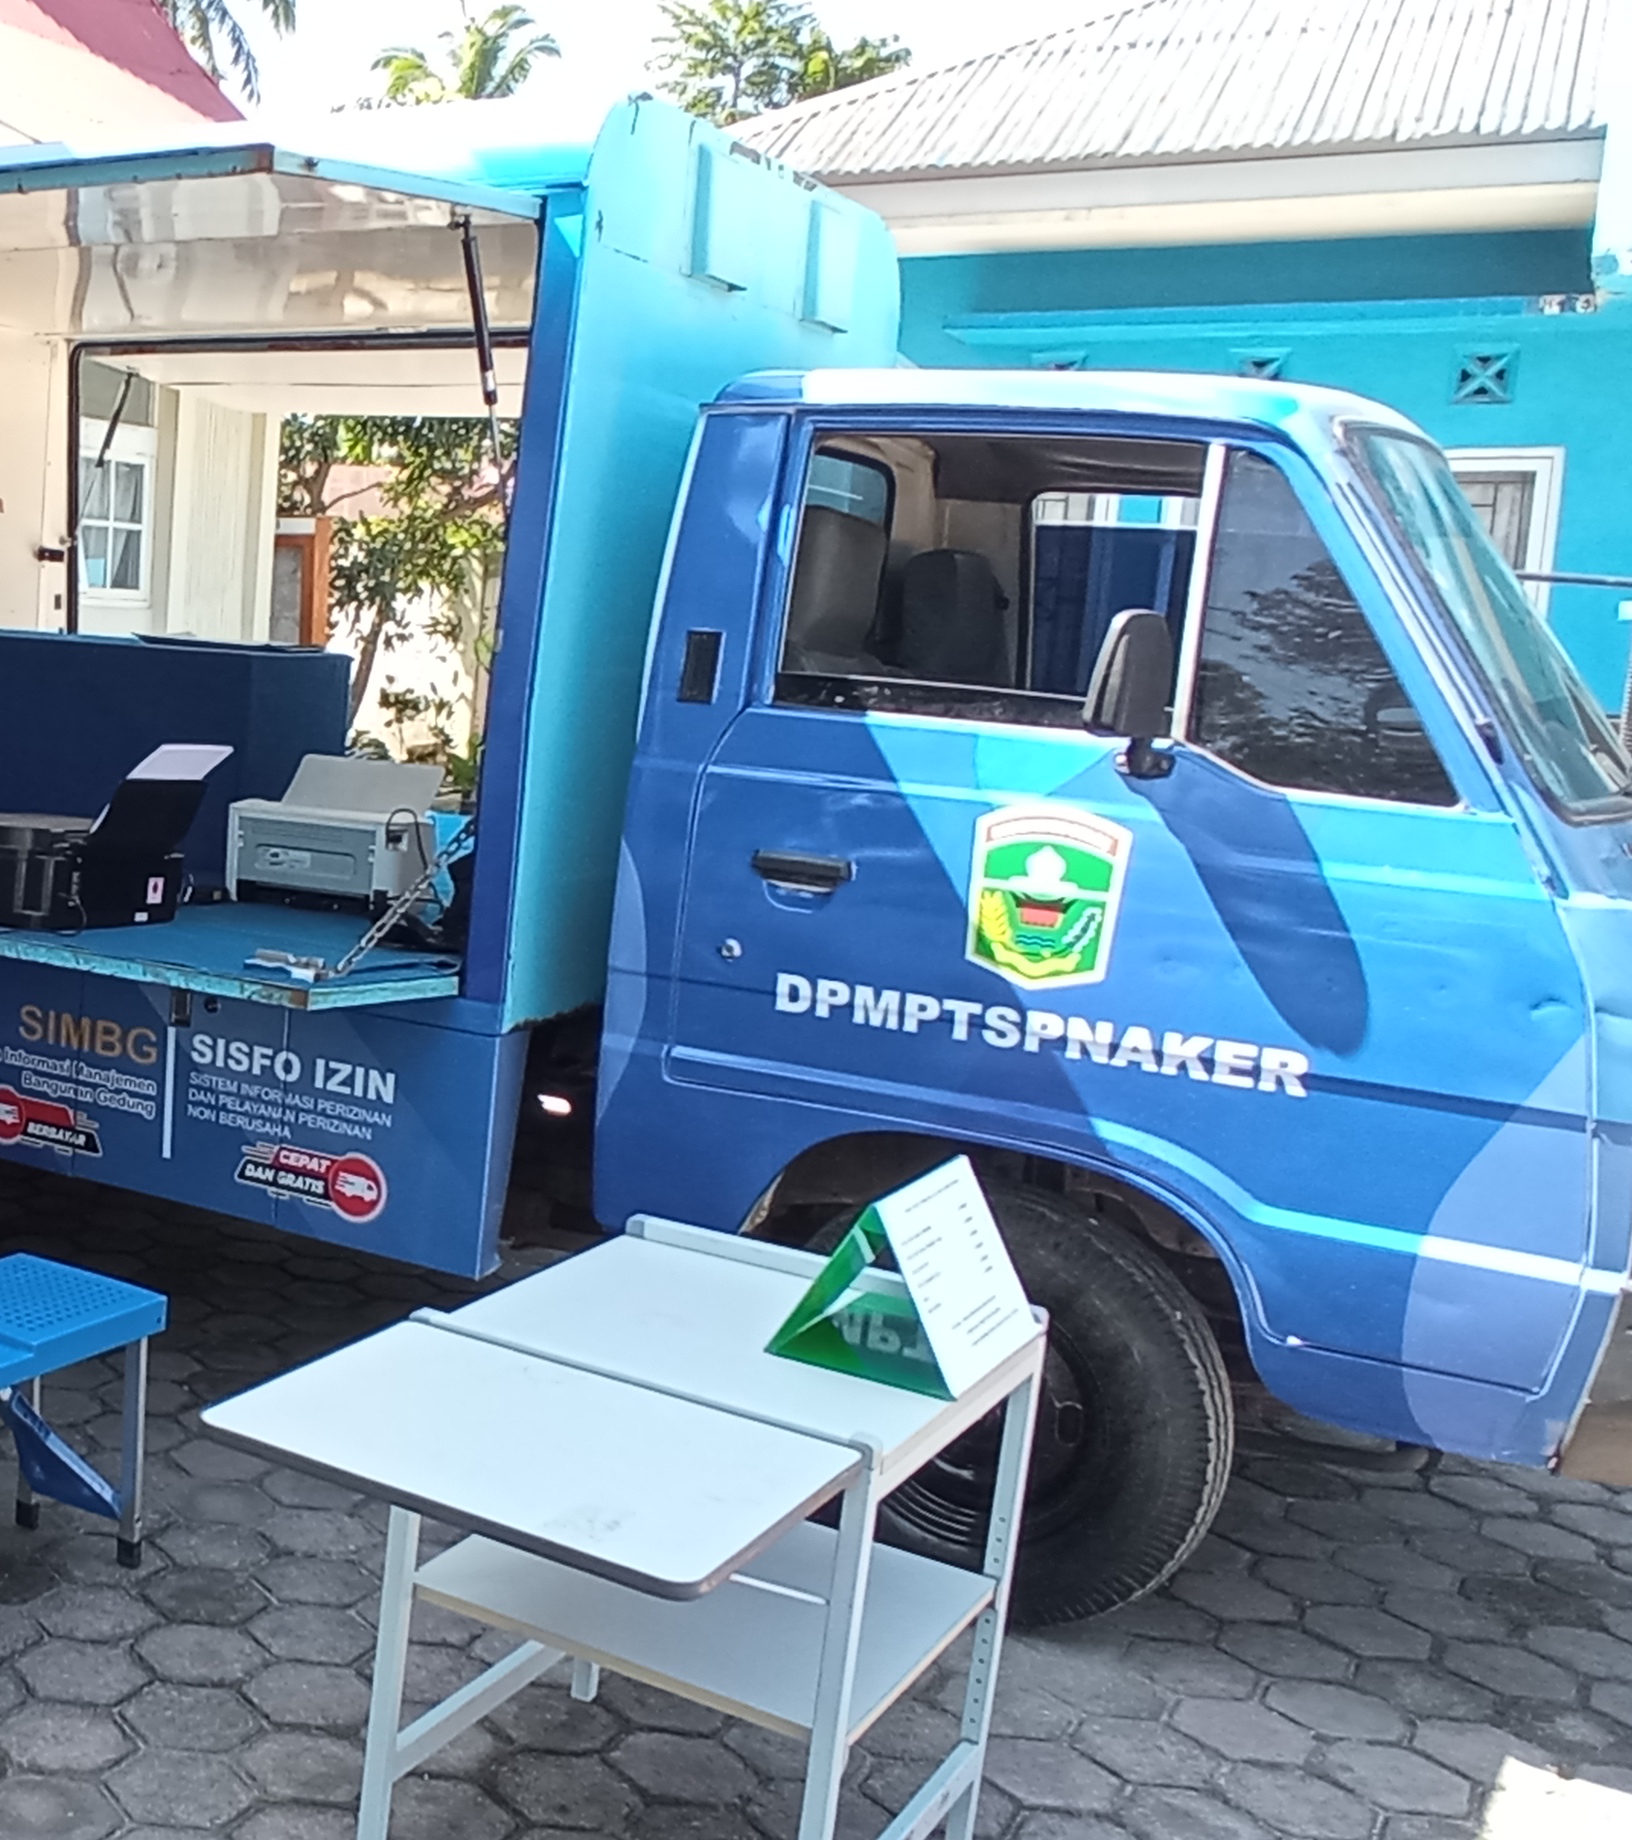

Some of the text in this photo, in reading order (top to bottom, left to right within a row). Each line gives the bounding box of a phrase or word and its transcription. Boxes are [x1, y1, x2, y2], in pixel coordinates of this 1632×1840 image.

[19, 1004, 158, 1065] SIMBG
[775, 972, 1310, 1098] DPMPTSPNAKER
[4, 1047, 71, 1076] Informasi
[190, 1033, 396, 1104] SISFO IZIN
[22, 1071, 157, 1120] Bangunan Gedung
[188, 1088, 372, 1140] DAN PELAYANAN PERIZINAN
[189, 1071, 392, 1128] SISTEM INFORMASI PERIZINAN
[27, 1122, 88, 1147] BERBAYAR
[187, 1104, 292, 1140] NON BERUSAHA
[244, 1164, 326, 1194] DAN GRATIS
[279, 1150, 331, 1173] CEPAT
